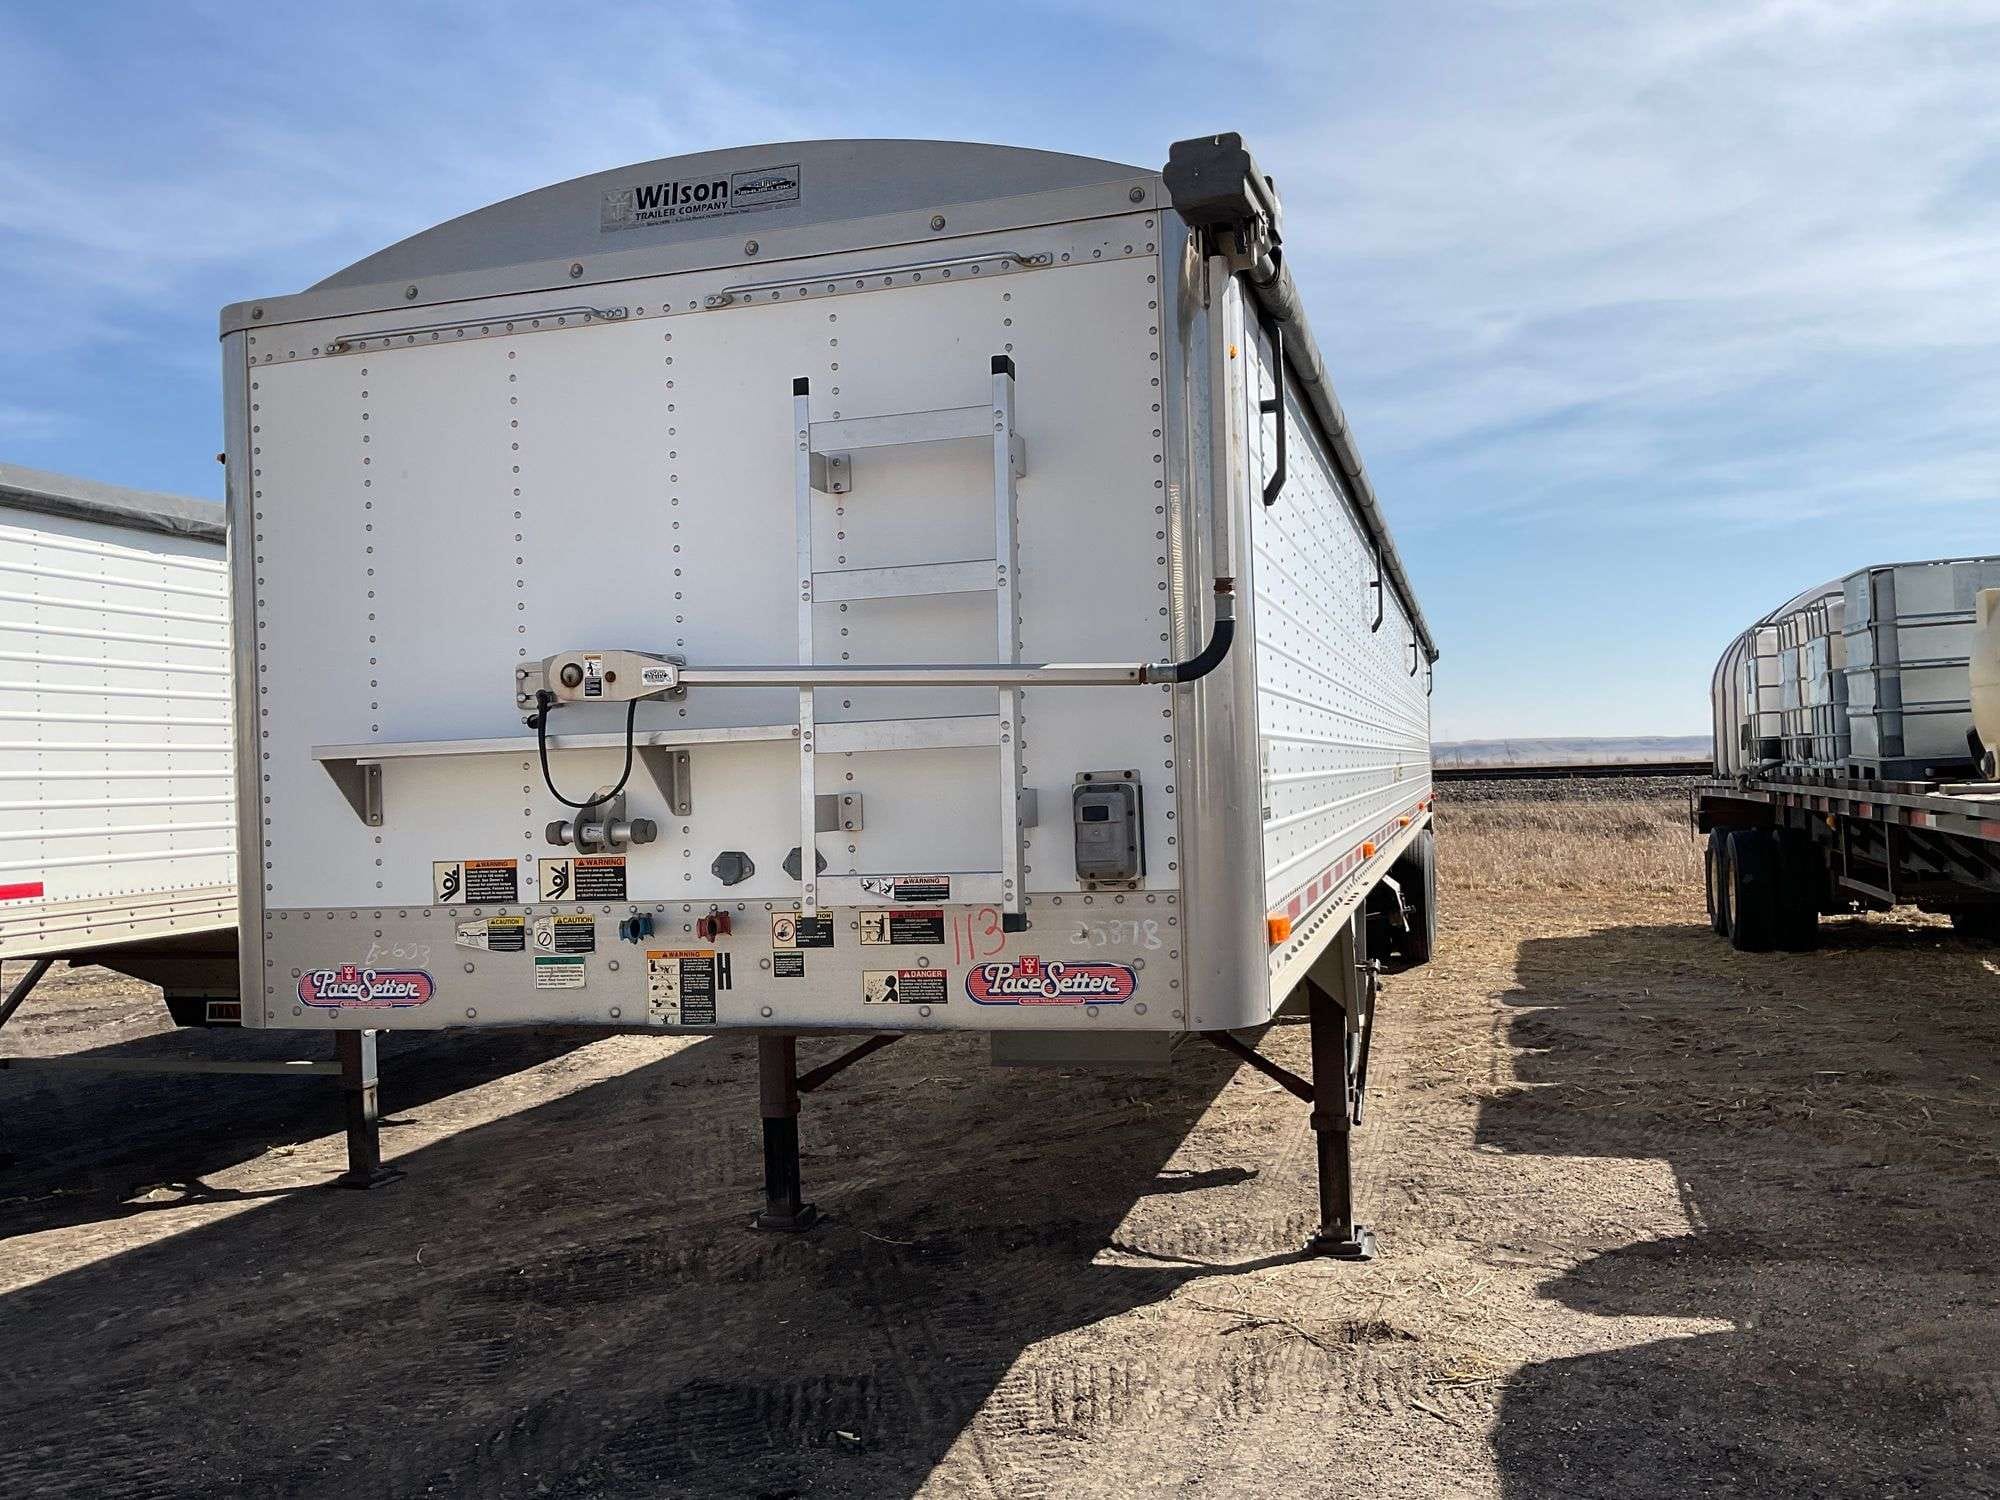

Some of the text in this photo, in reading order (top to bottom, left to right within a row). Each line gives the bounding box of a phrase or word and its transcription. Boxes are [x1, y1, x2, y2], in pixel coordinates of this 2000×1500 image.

[636, 180, 728, 209] Wilson
[636, 209, 676, 221] TRAILER
[679, 200, 728, 215] COMPANY
[909, 877, 940, 885] WARNING
[562, 916, 593, 924] CAUTION
[953, 908, 1006, 966] 113
[313, 969, 420, 1001] PaceSetter
[717, 952, 732, 990] H
[910, 970, 943, 978] DANGER
[984, 961, 1120, 998] PaceSetter
